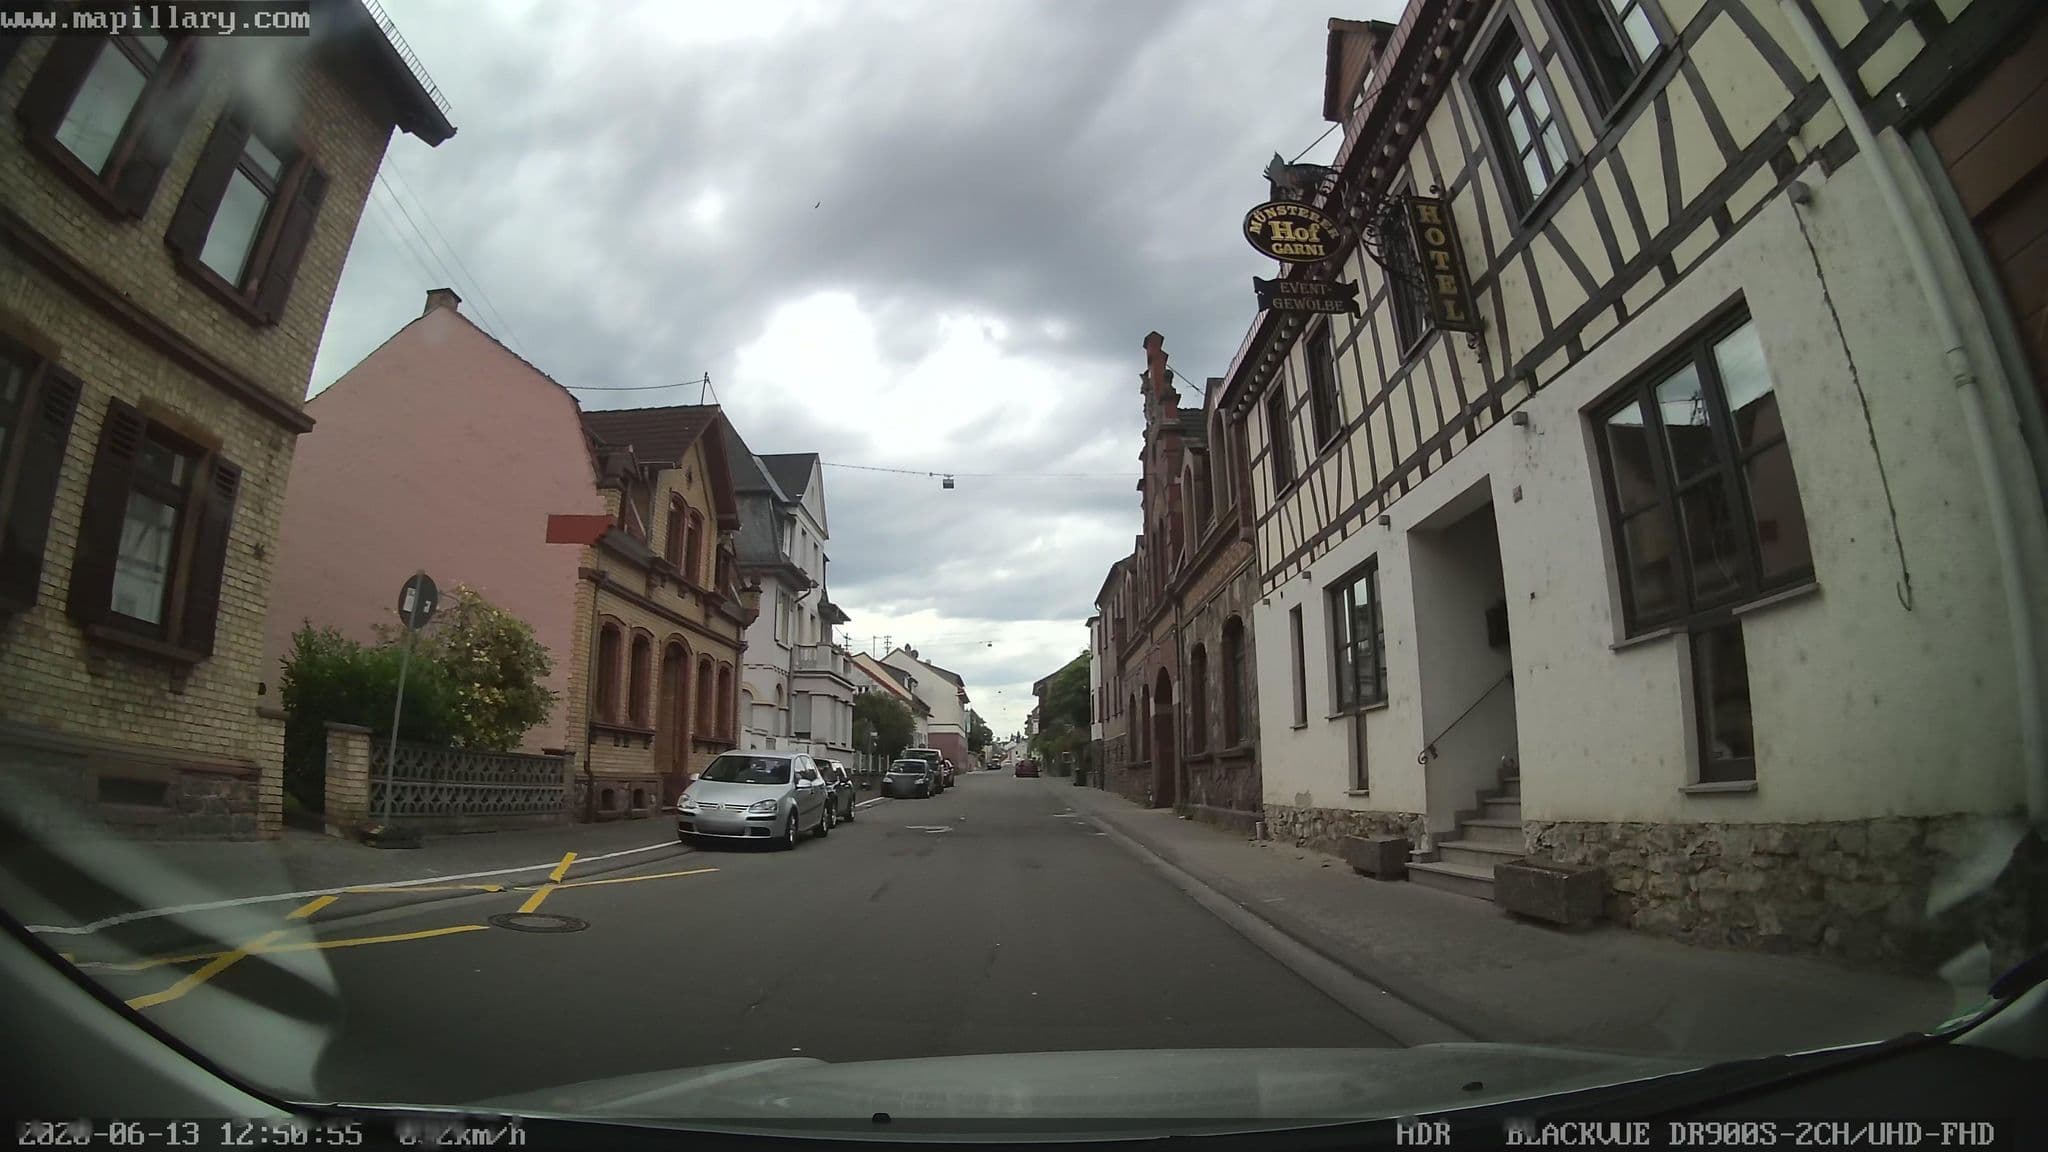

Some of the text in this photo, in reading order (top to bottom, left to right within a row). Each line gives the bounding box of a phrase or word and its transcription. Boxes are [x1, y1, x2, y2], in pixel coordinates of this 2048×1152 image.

[1249, 205, 1340, 240] MÜNSTERER
[1268, 220, 1321, 243] Hof
[1271, 242, 1326, 256] GARNI
[1415, 204, 1465, 321] HOTEL
[1279, 281, 1332, 295] EVENT-
